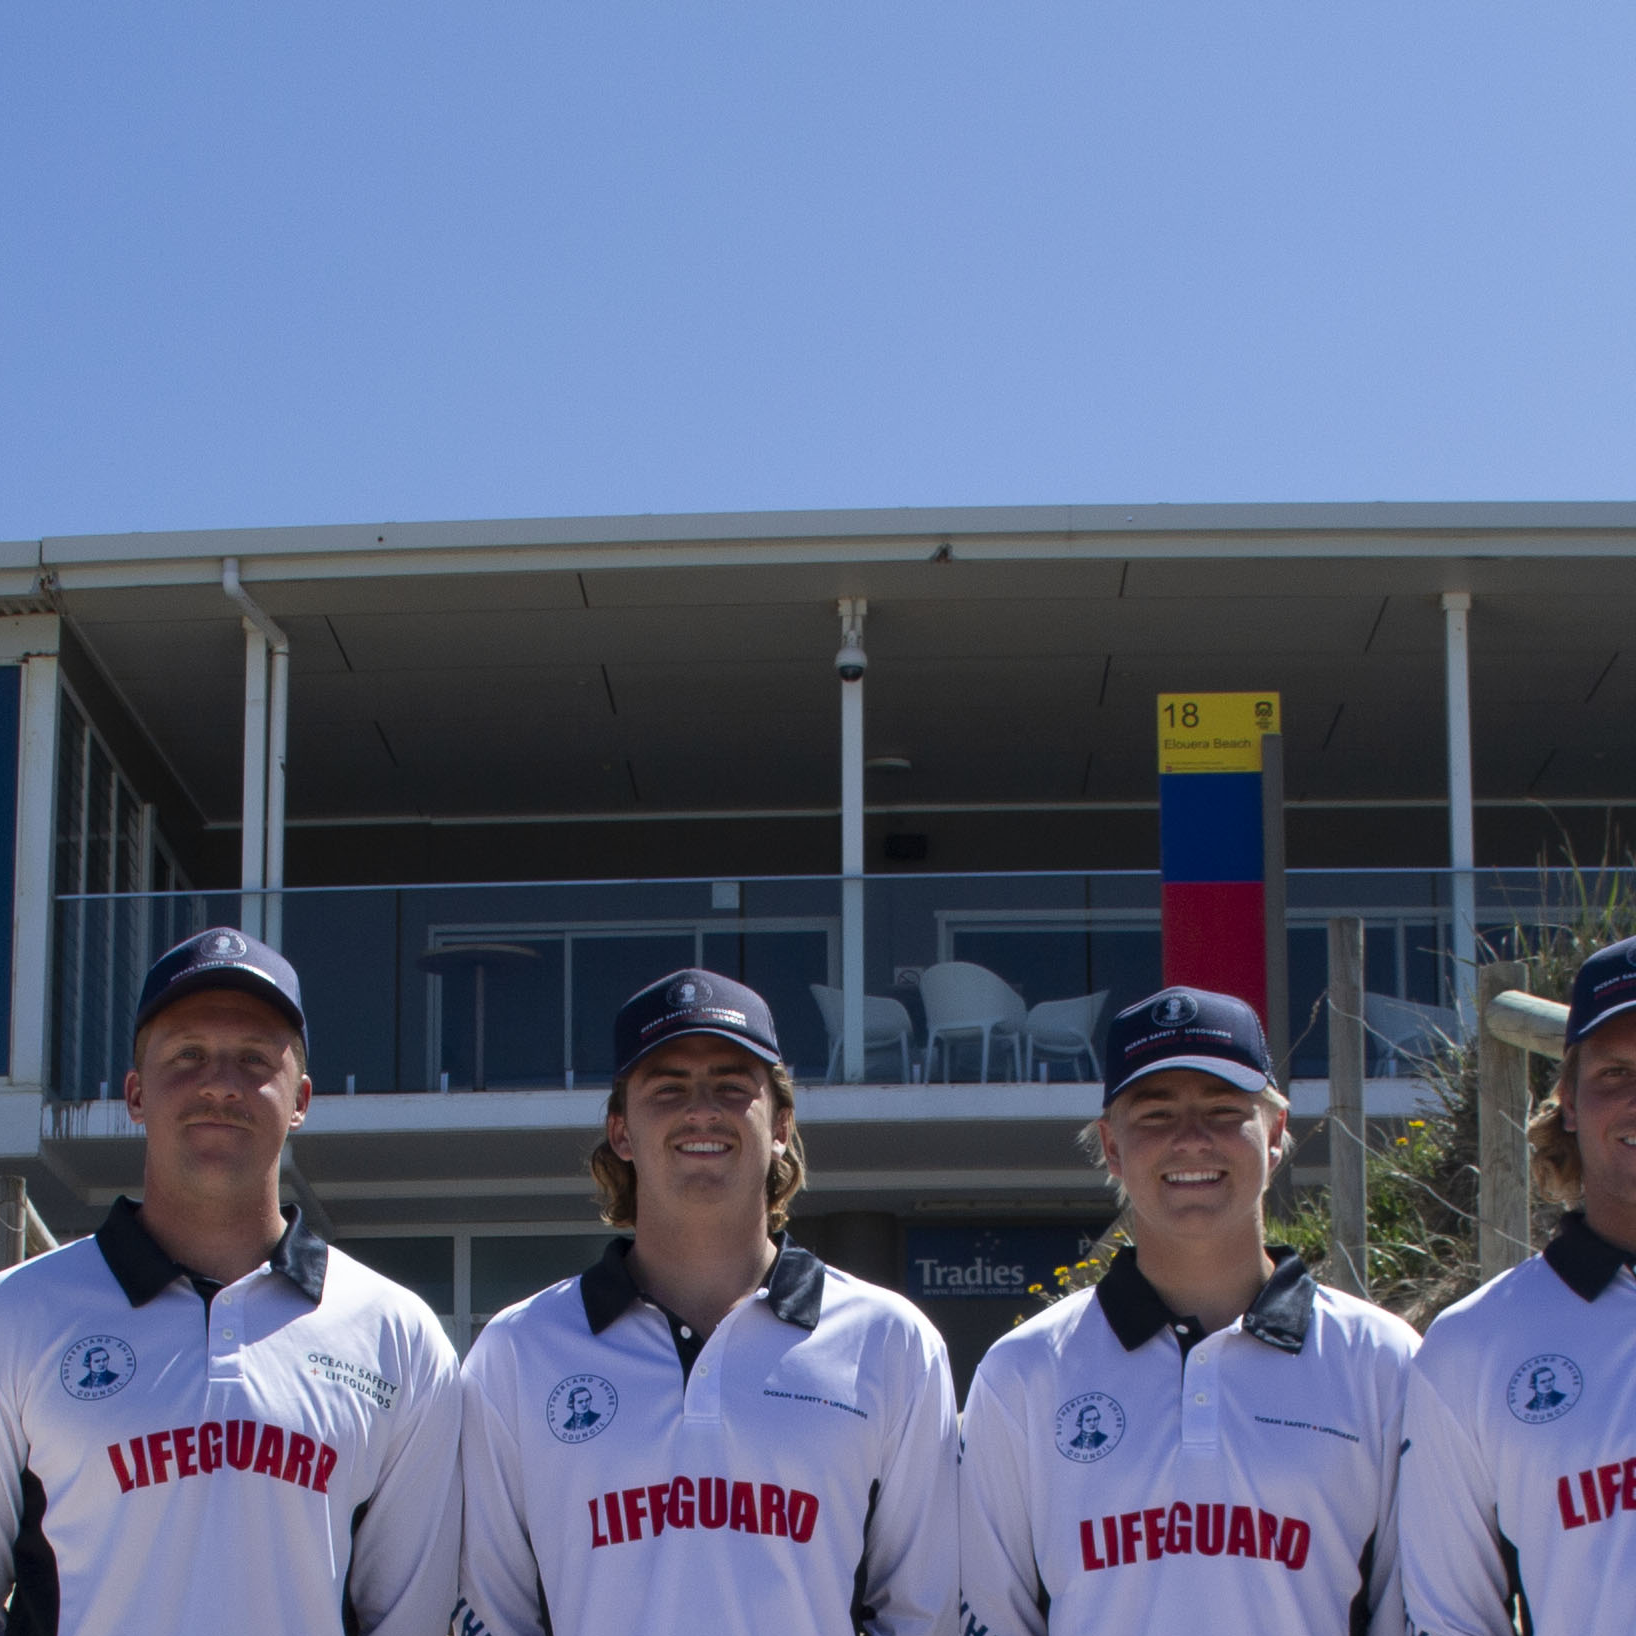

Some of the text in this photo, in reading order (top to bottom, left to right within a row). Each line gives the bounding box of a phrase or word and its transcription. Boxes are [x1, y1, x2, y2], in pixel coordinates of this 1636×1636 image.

[1164, 702, 1199, 728] 18
[1164, 737, 1252, 750] Elouera Beach
[915, 1258, 1025, 1286] Tradies
[921, 1285, 1025, 1297] www.tradies.com.au
[307, 1353, 398, 1396] OCEAN SAFETY
[77, 1381, 125, 1398] COUNCIL
[325, 1371, 392, 1410] LIFEGUARDS
[763, 1389, 792, 1399] OCEAN
[794, 1393, 822, 1403] SAFETY
[562, 1421, 605, 1441] COUNCIL
[107, 1419, 338, 1495] LIFEGUARD
[1066, 1444, 1113, 1461] COUNCIL
[587, 1475, 820, 1550] LIFEGUARD
[1079, 1501, 1311, 1571] LIFEGUARD
